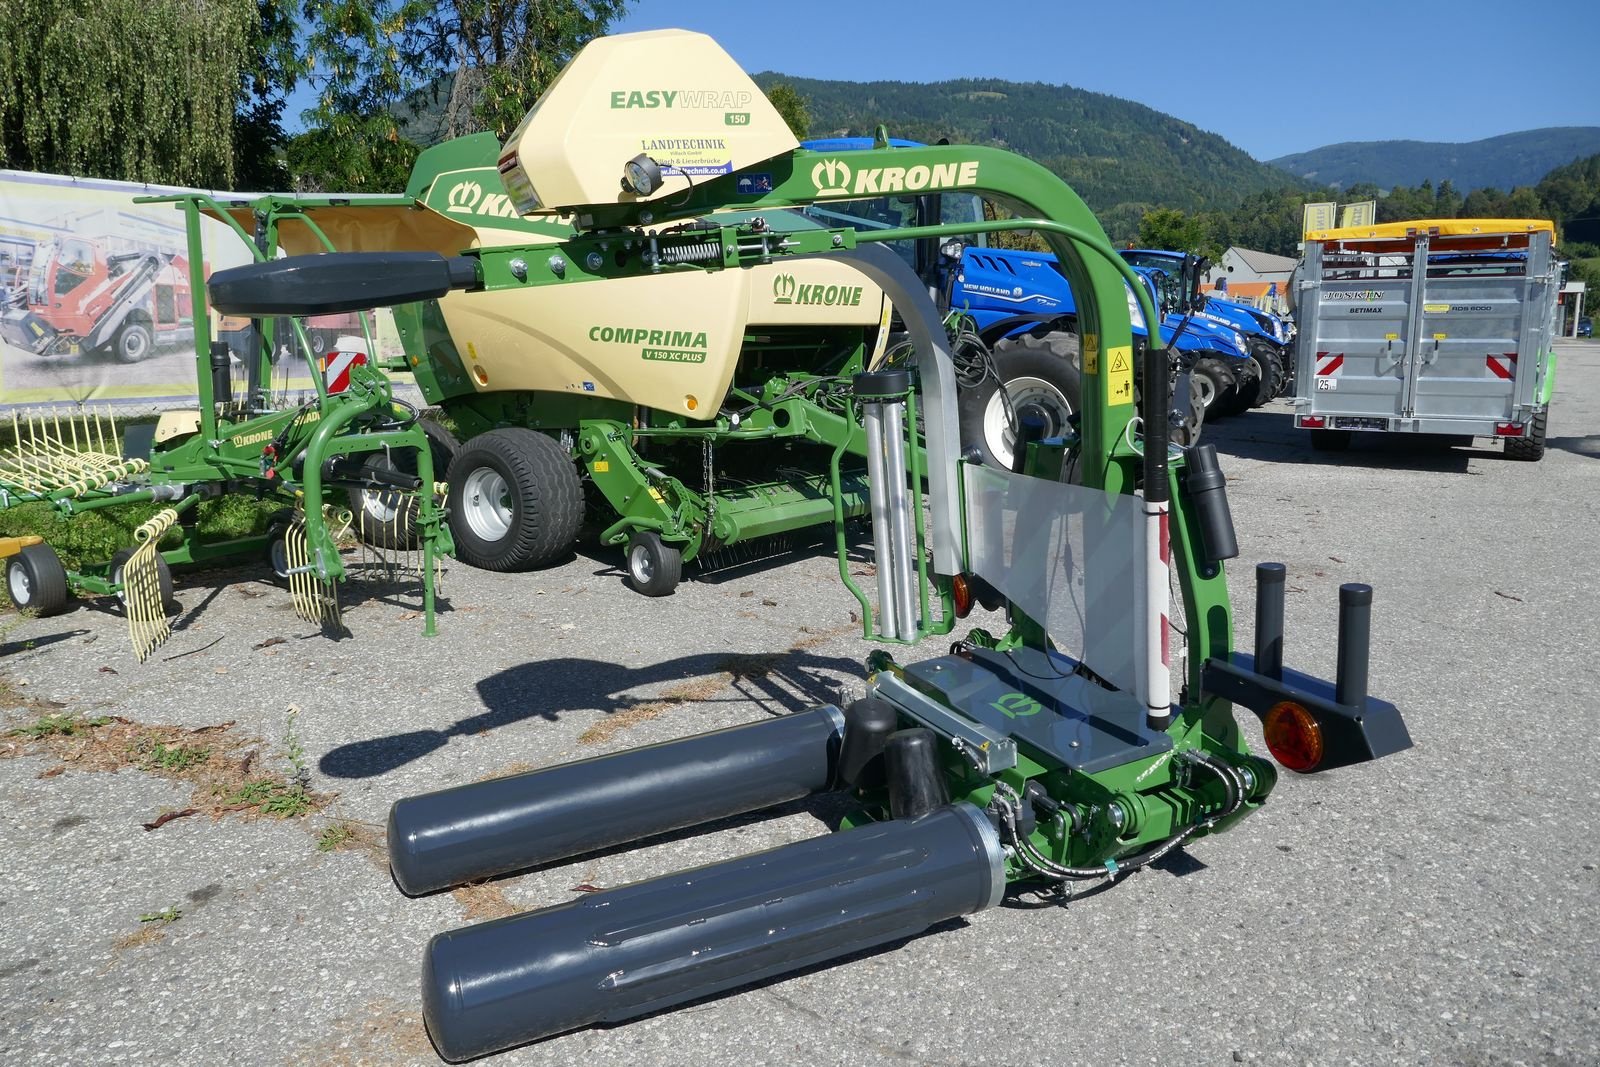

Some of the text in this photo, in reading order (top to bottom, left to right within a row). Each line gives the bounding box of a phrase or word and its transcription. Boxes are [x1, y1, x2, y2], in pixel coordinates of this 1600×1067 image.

[730, 114, 746, 124] 150
[641, 138, 726, 151] LANDTECHNIK
[853, 160, 980, 194] KRONE
[794, 283, 864, 306] KRONE
[979, 285, 1011, 296] HOLLAND
[1324, 289, 1385, 301] JOSKIN
[588, 325, 708, 349] COMPRIMA
[646, 350, 703, 362] V 150 XC PLUS
[1319, 379, 1329, 391] 25
[242, 429, 273, 446] KRONE
